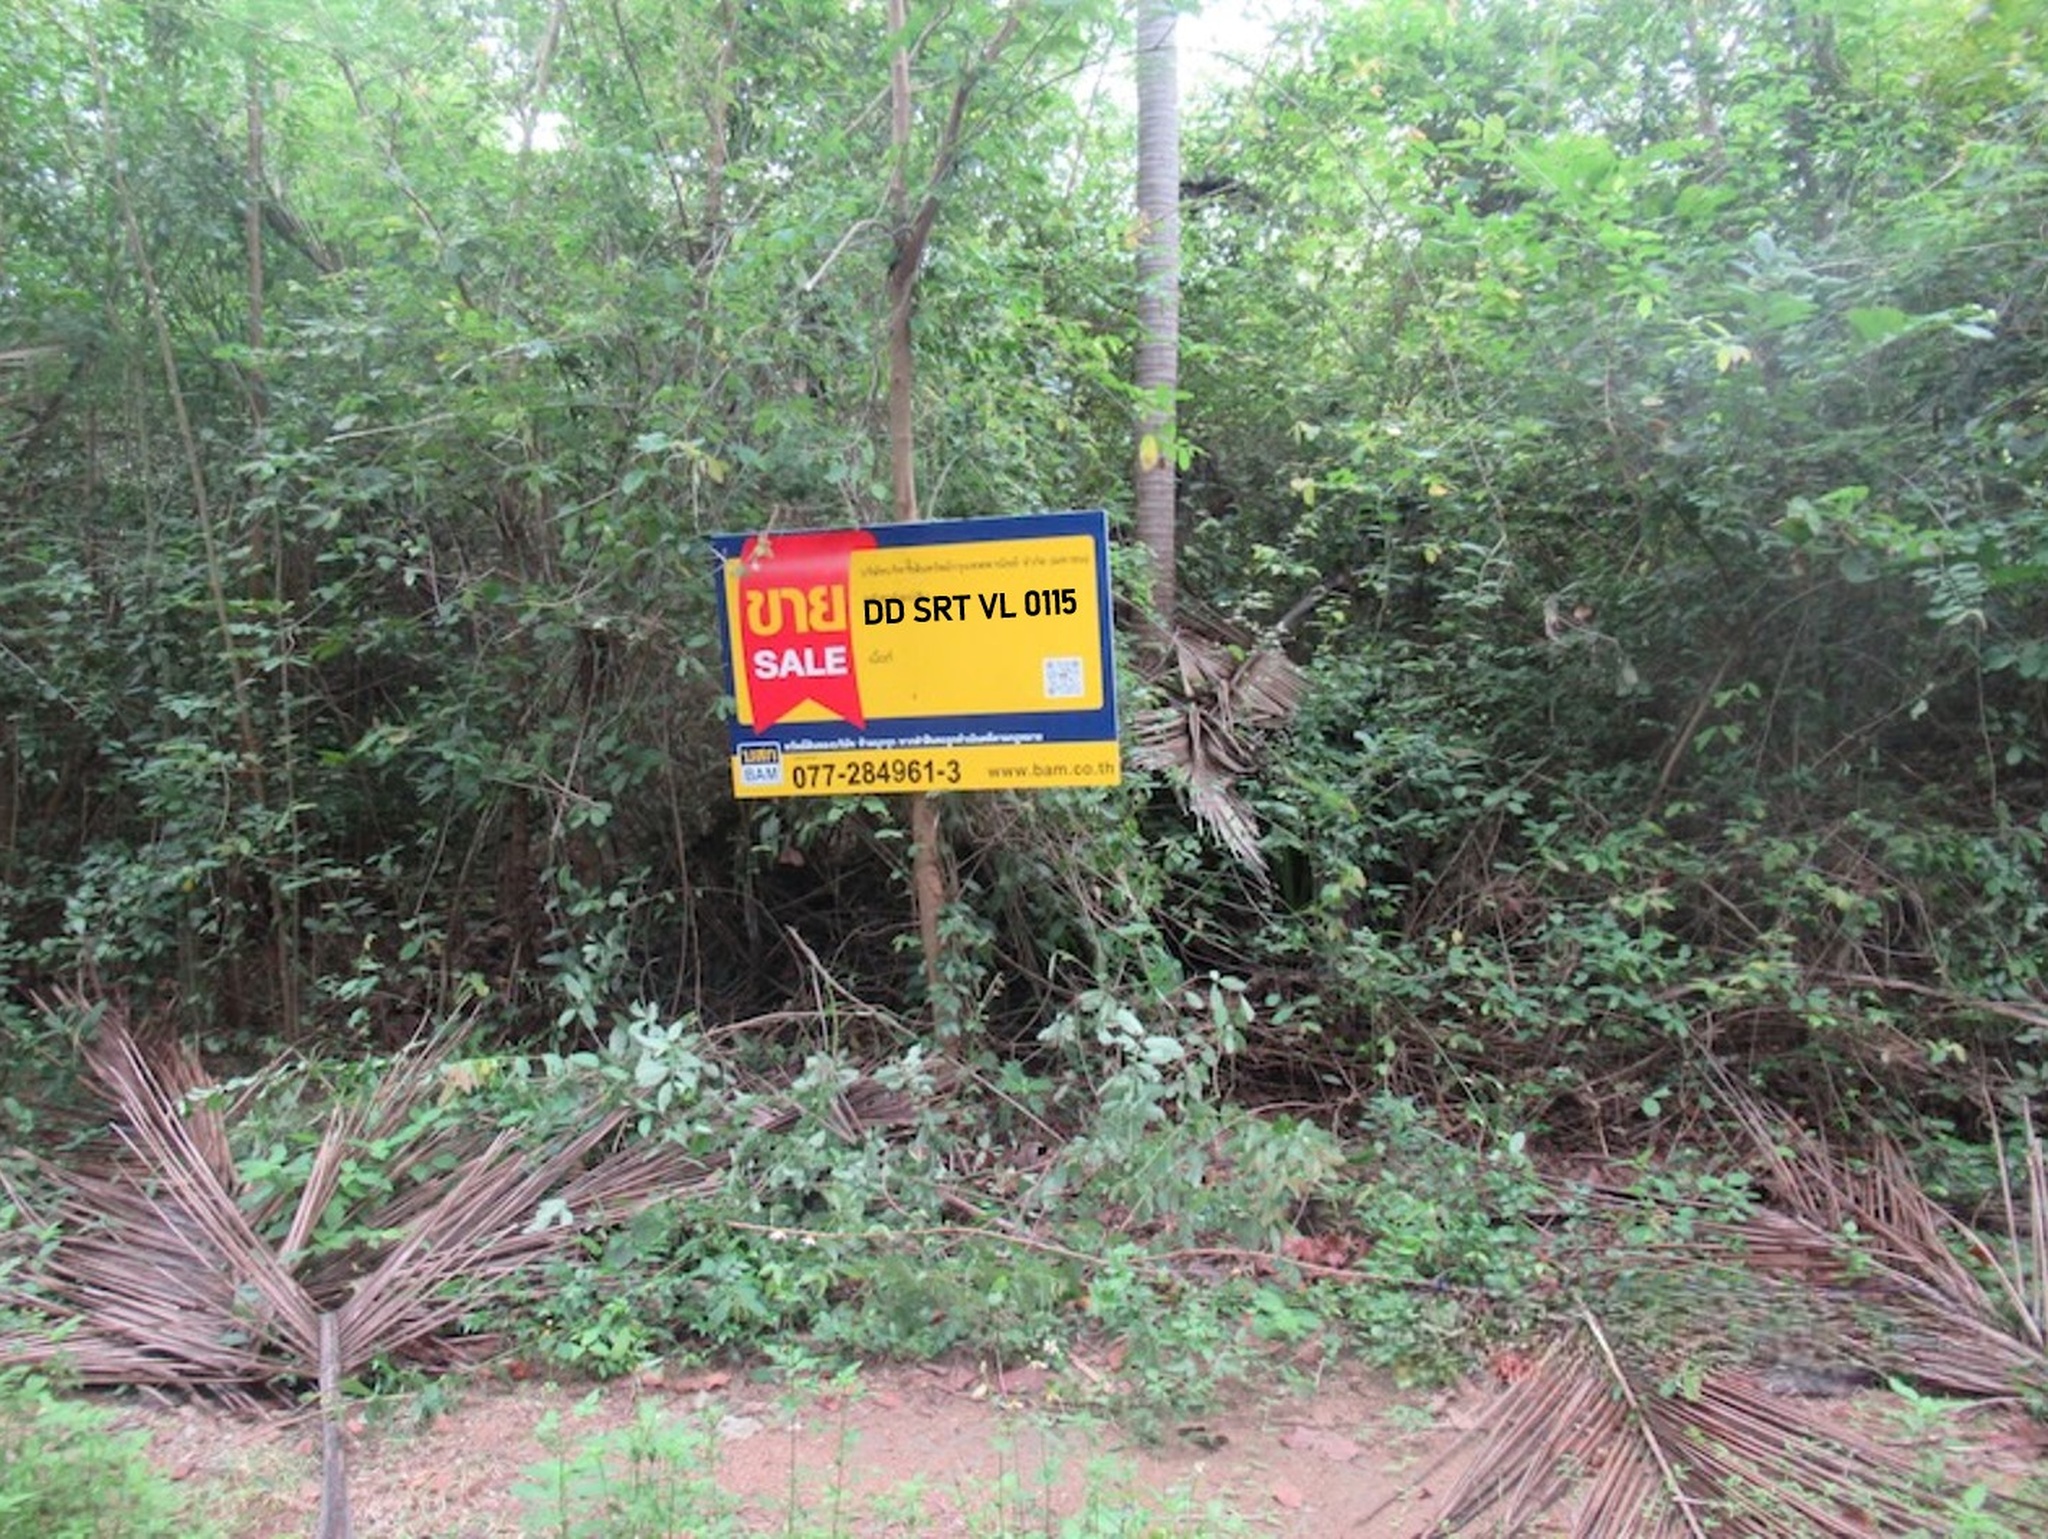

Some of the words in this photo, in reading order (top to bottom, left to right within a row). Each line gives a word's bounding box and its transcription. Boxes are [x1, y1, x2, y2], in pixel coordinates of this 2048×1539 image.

[746, 584, 848, 637] ขาย
[753, 645, 849, 680] SALE
[744, 766, 778, 782] BAM
[793, 759, 961, 789] 077-284961-3
[988, 762, 1115, 778] www.bam.co.th
